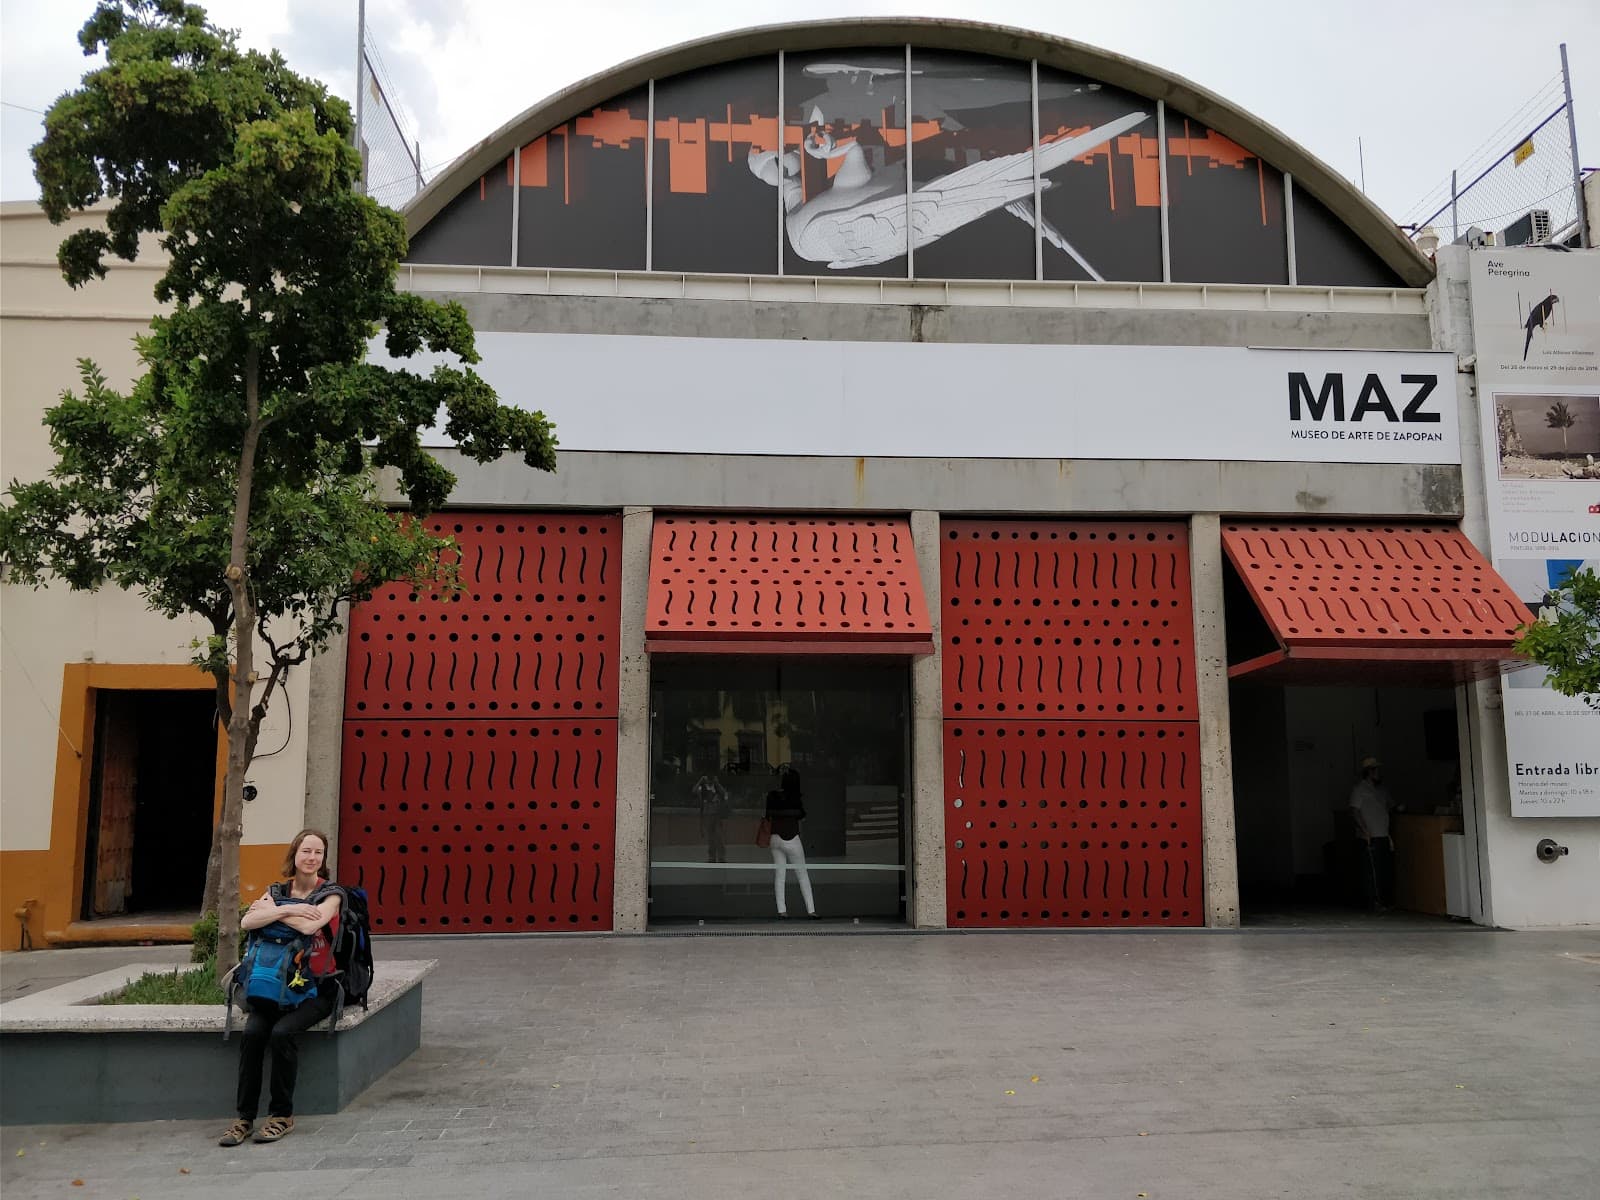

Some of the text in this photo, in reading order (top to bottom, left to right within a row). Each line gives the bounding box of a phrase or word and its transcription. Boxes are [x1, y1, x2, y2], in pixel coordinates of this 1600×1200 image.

[1487, 260, 1504, 268] Ave
[1488, 268, 1530, 278] Peregrina
[1287, 371, 1441, 423] MAZ
[1290, 429, 1443, 442] MUSEO DE ARTE DE ZAPOPAN
[1515, 762, 1570, 776] Entrada
